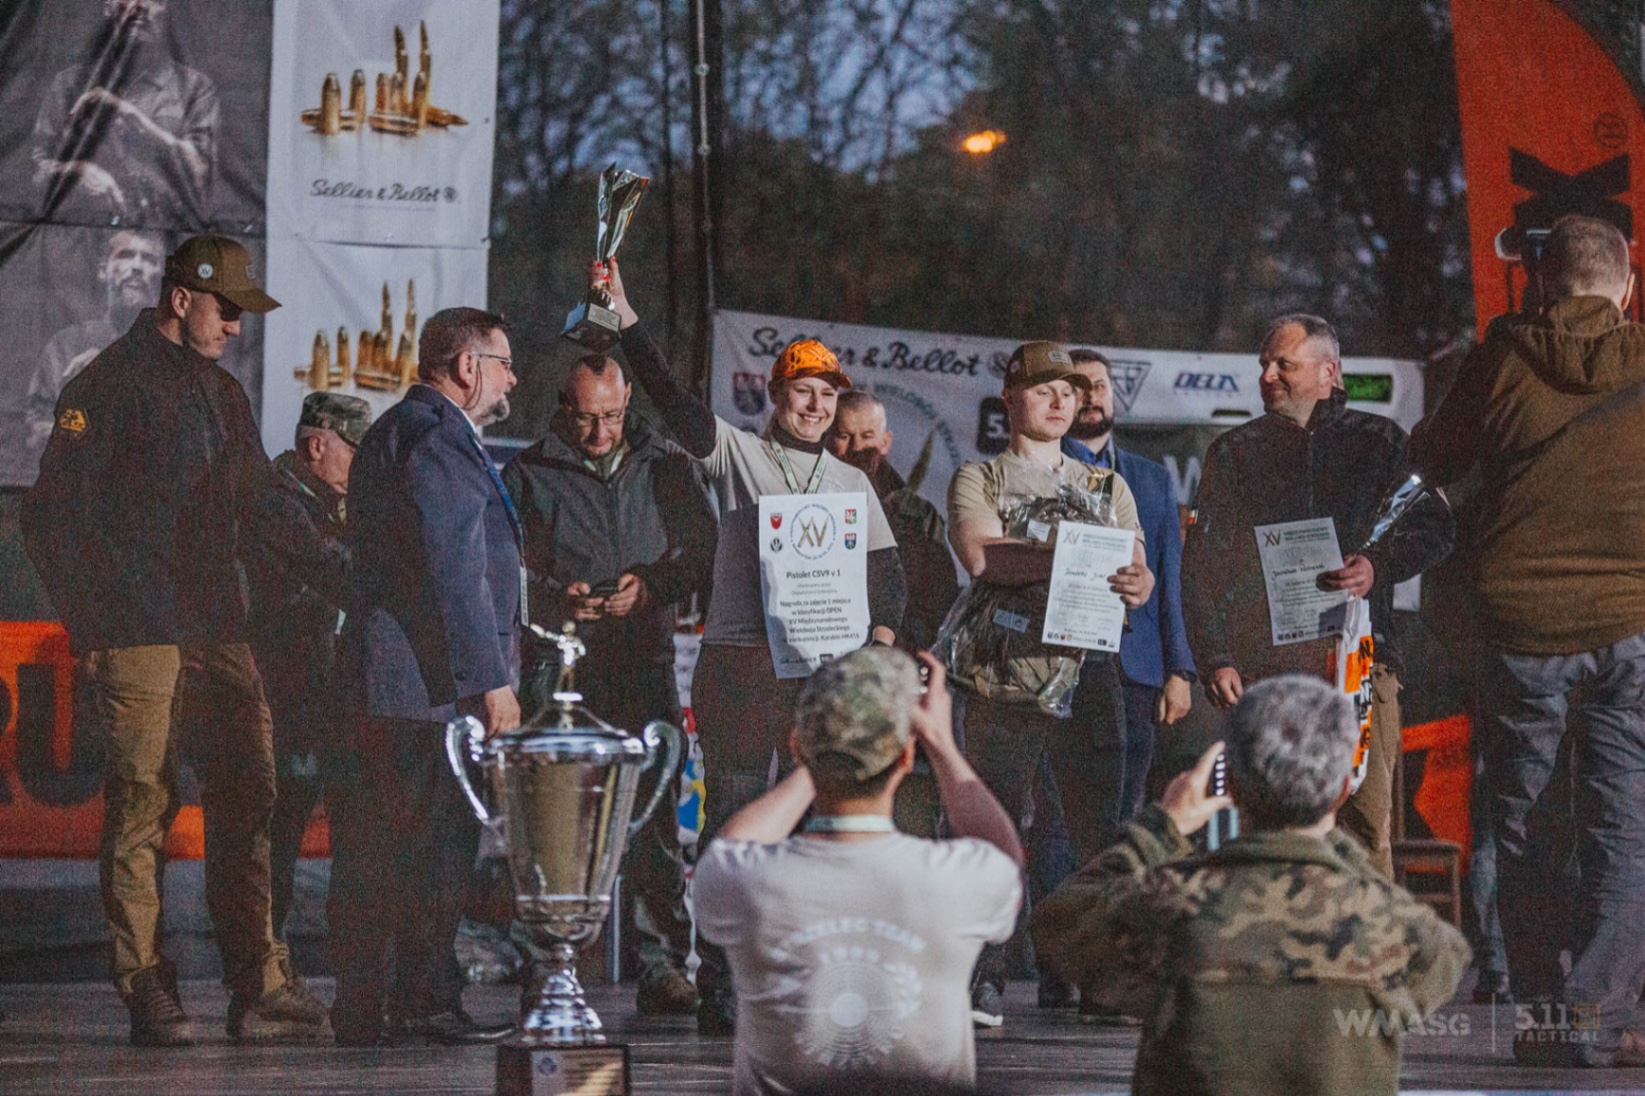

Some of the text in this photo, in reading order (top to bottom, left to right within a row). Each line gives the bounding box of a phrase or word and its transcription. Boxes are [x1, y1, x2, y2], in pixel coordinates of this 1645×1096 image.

[861, 346, 881, 368] &
[881, 341, 986, 377] Bellot
[797, 516, 830, 549] XV
[1263, 529, 1281, 548] XV
[786, 571, 811, 579] Pistolet
[812, 569, 830, 578] CSV9
[780, 600, 802, 608] Nagroda
